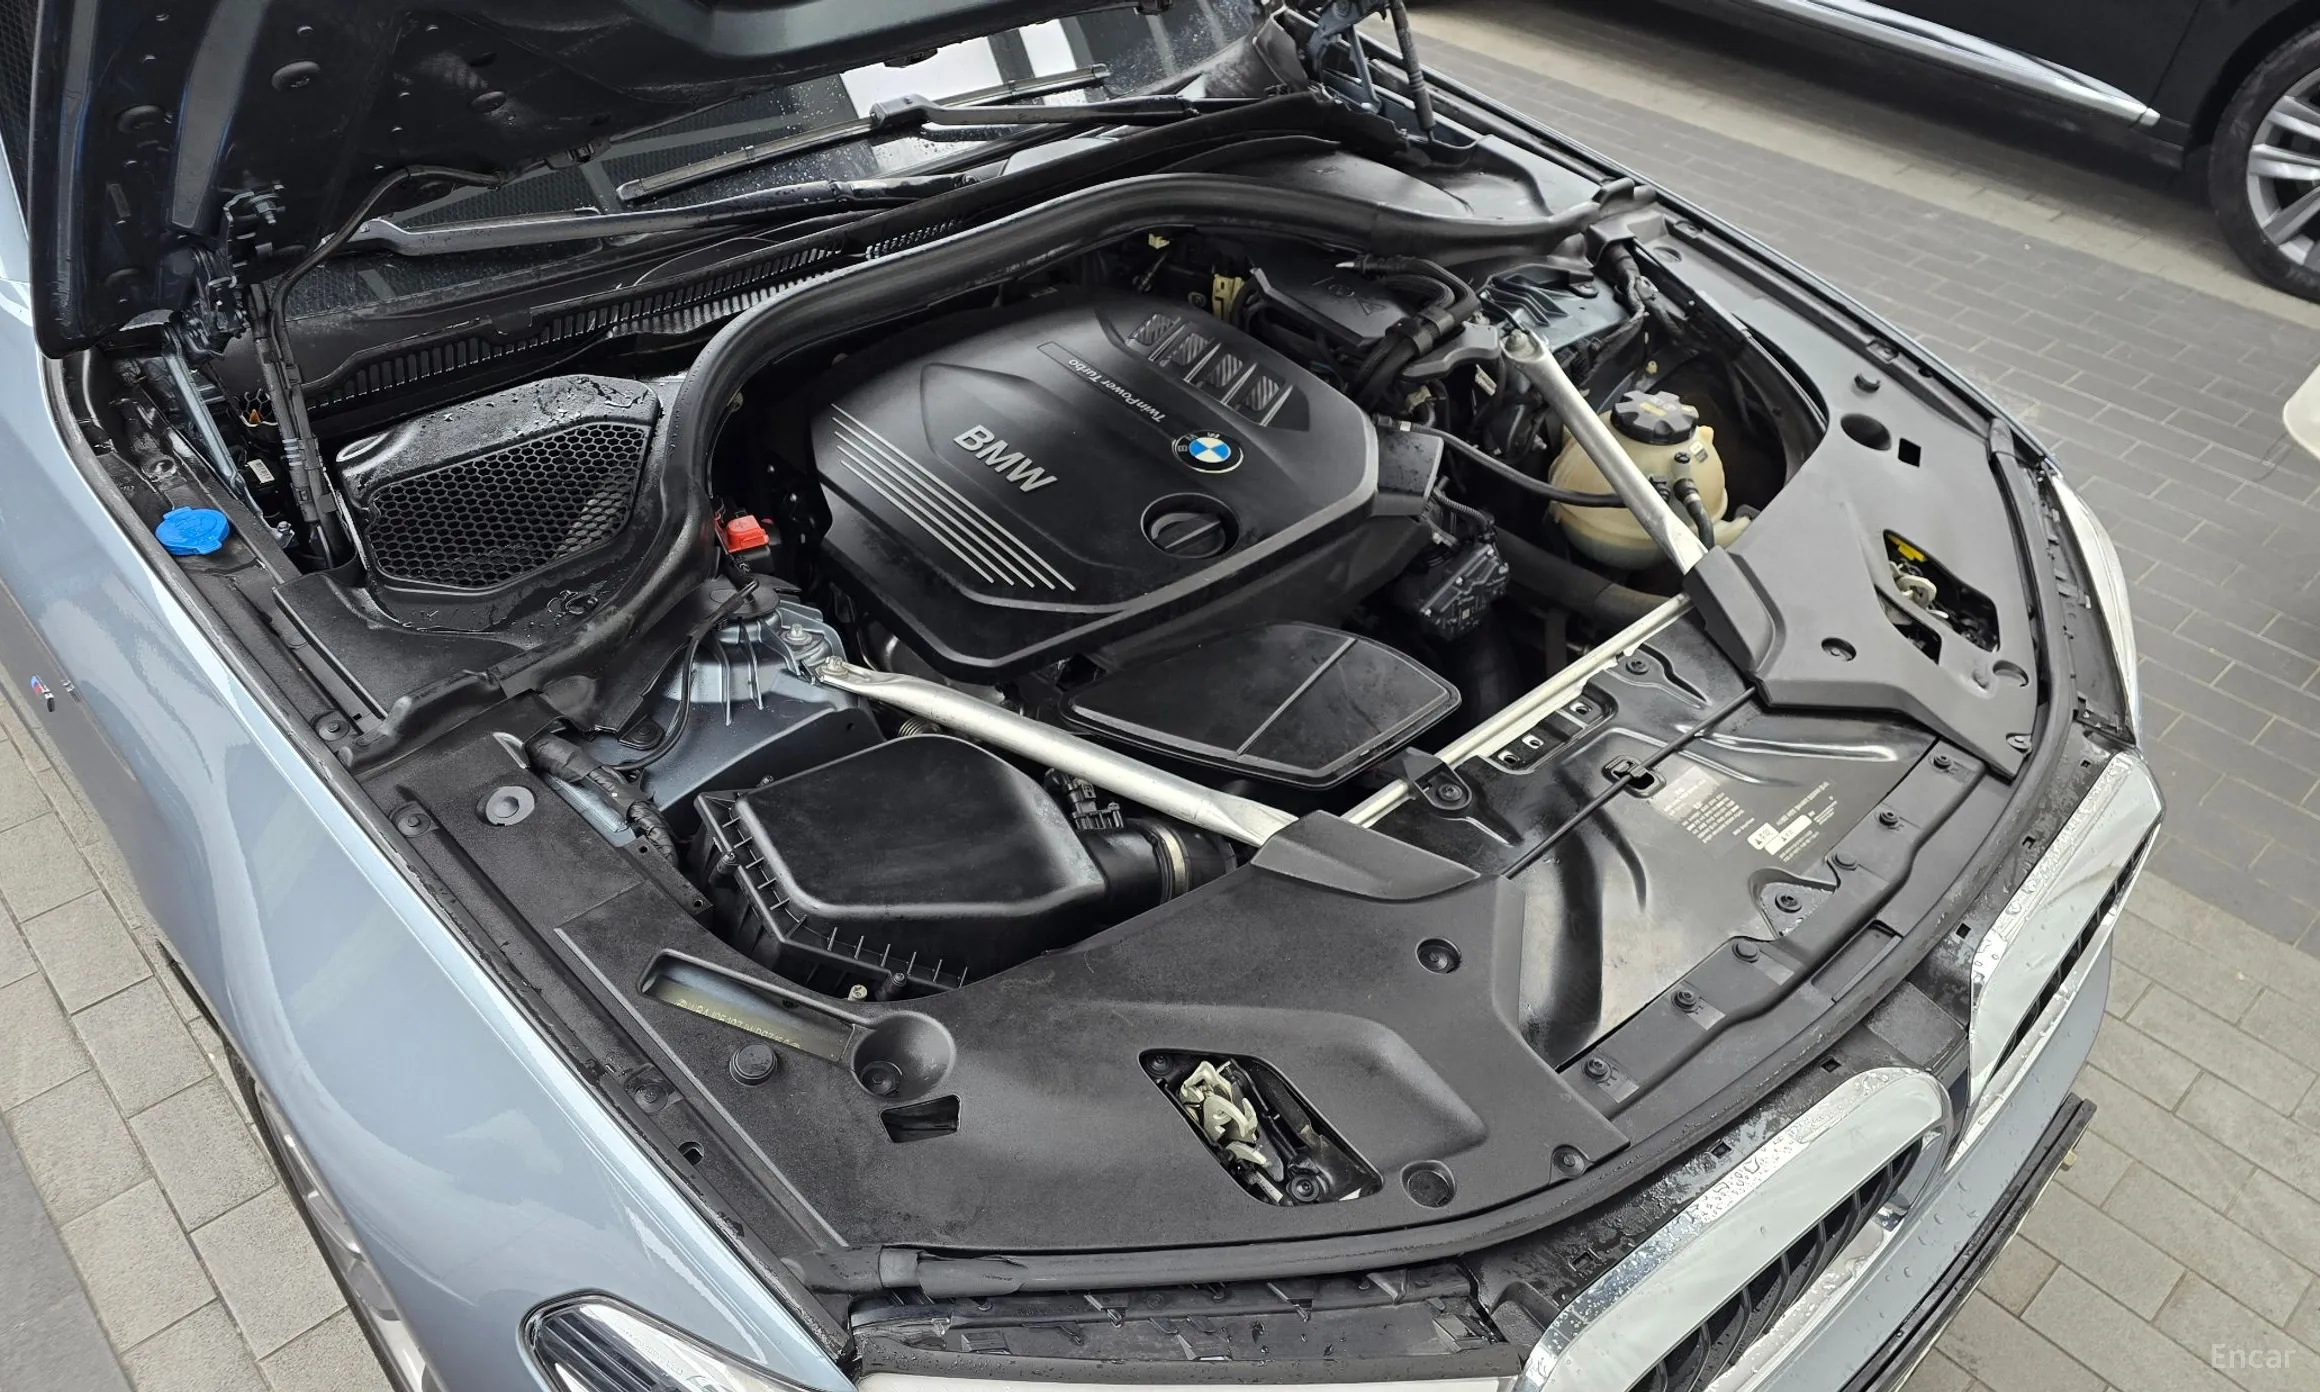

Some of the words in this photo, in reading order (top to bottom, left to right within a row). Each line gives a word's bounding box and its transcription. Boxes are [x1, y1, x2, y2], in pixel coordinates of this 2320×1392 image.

[1068, 359, 1102, 383] Turbo
[1100, 380, 1166, 423] TwinPower
[953, 424, 1058, 493] BMW
